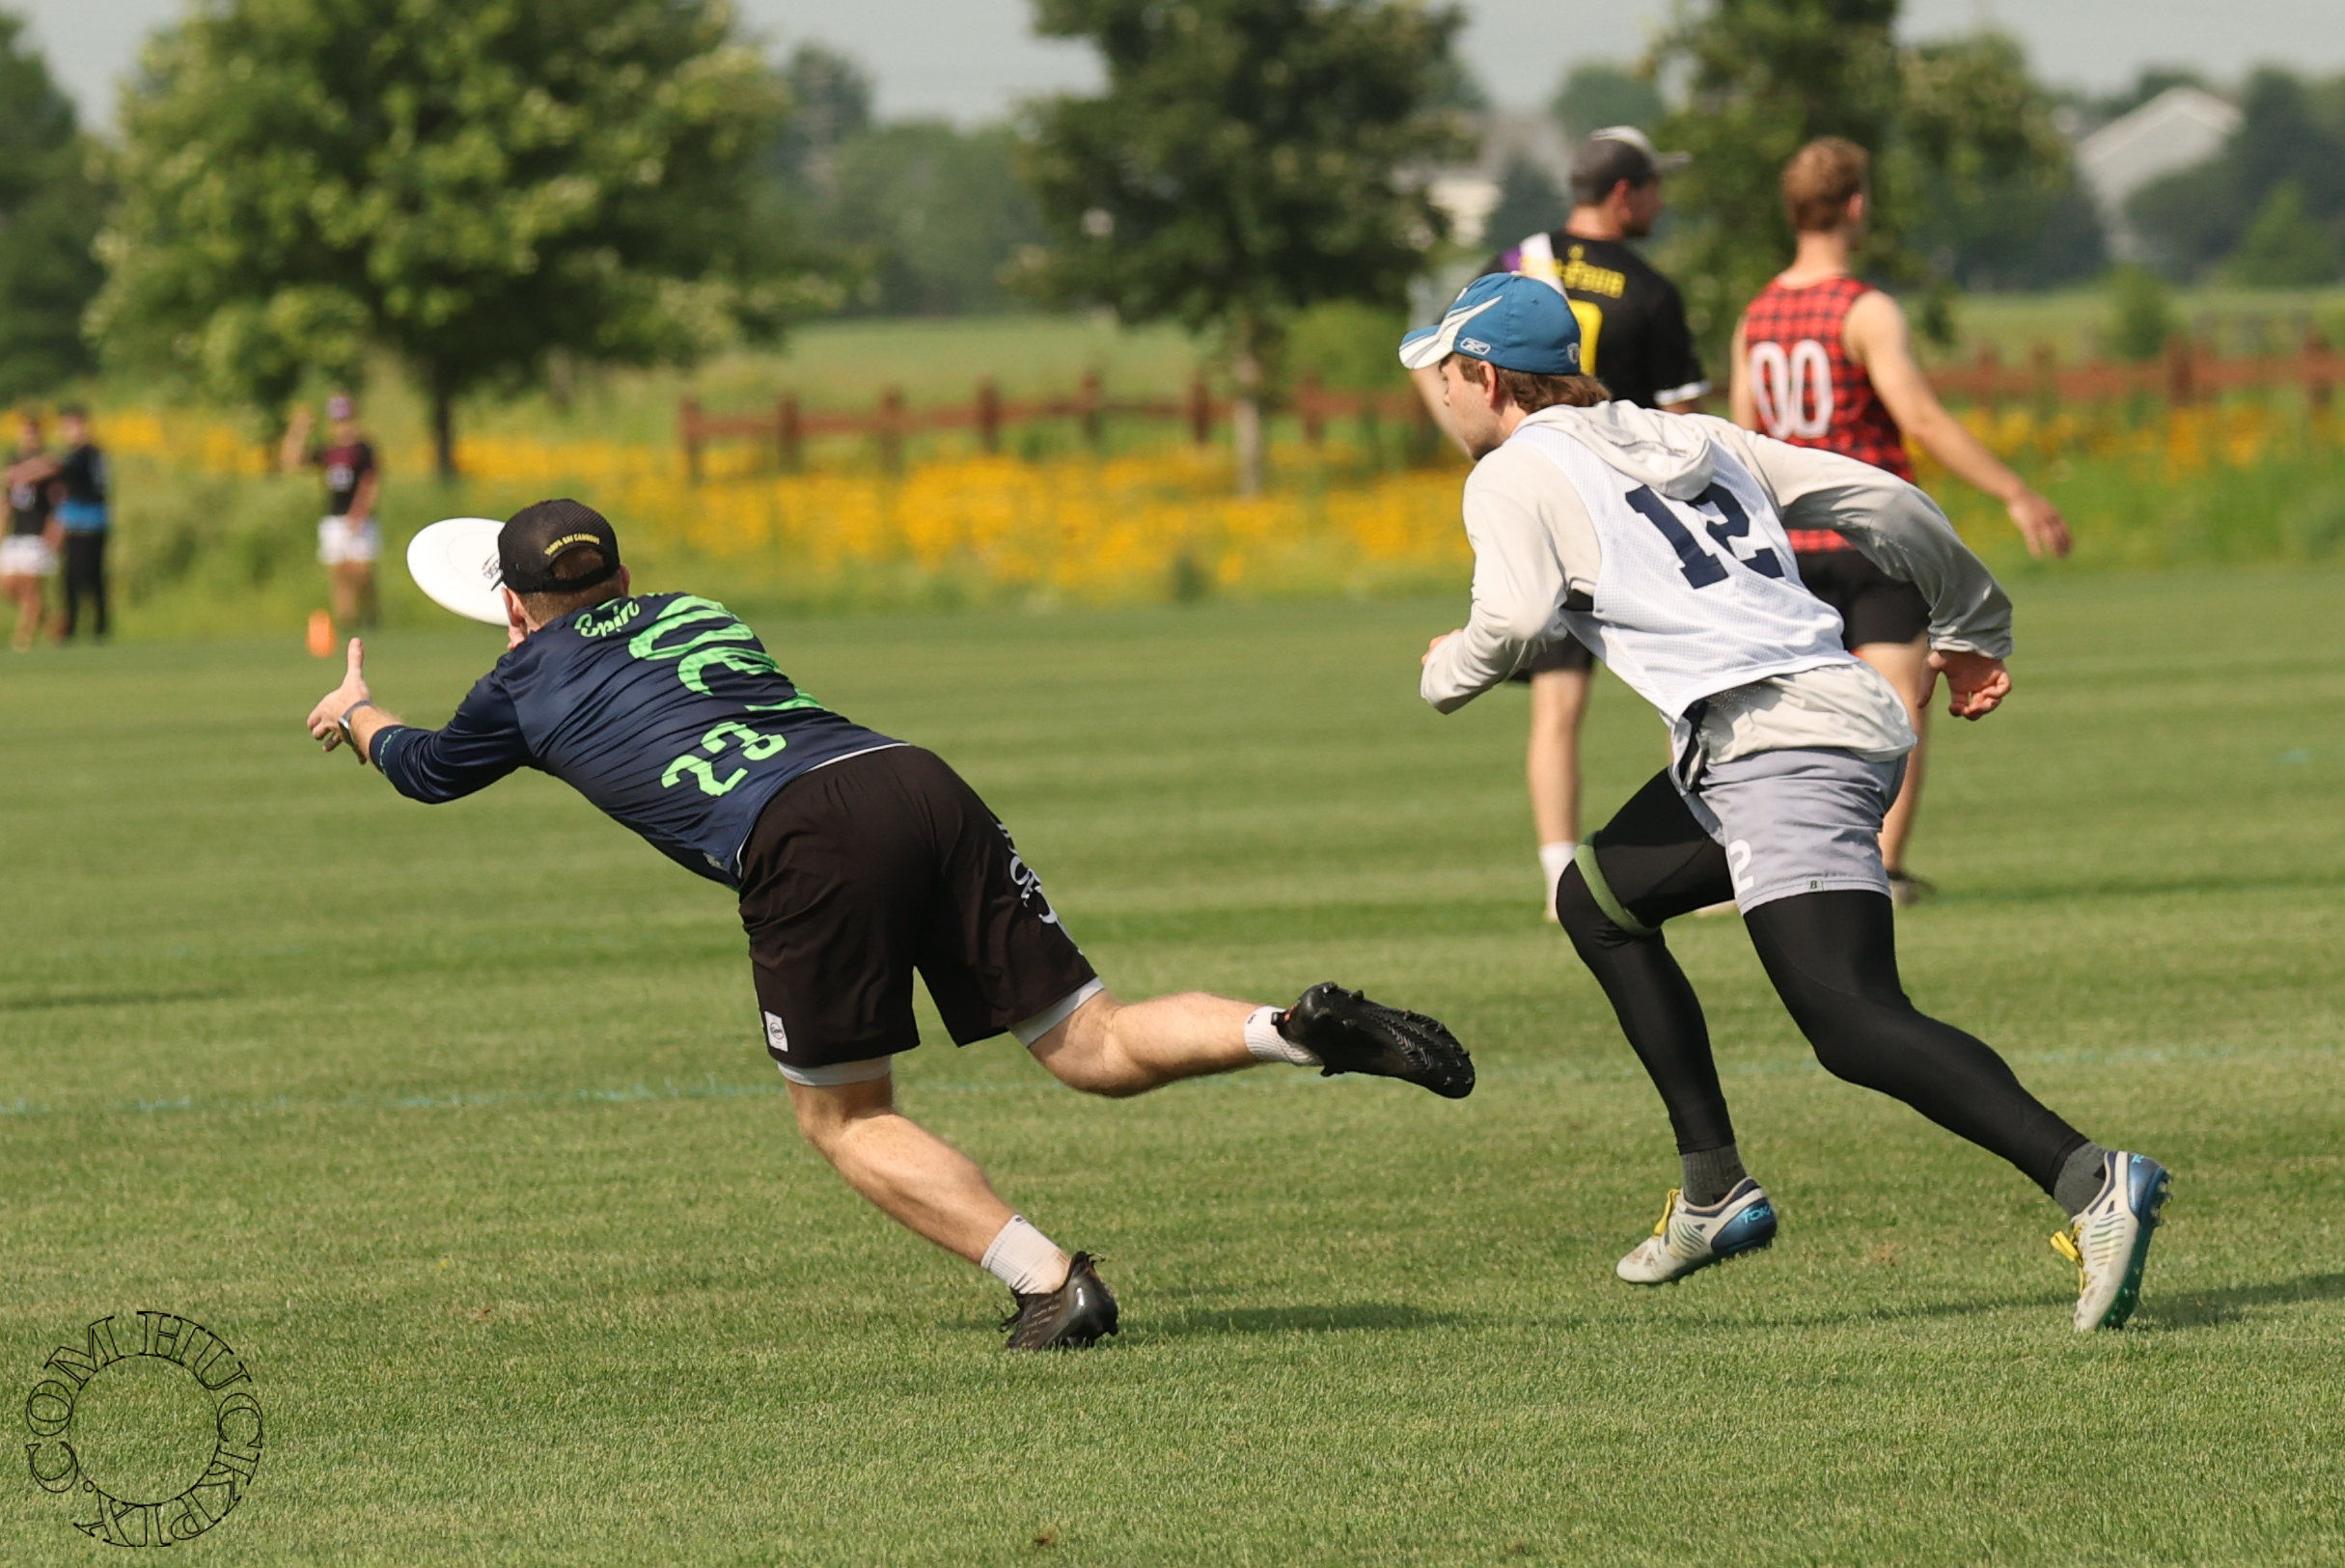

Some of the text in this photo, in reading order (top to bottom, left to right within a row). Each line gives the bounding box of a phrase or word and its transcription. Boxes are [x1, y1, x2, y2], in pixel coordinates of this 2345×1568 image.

[1750, 339, 1835, 439] 00
[1625, 482, 1785, 590] 12
[661, 721, 786, 797] 23
